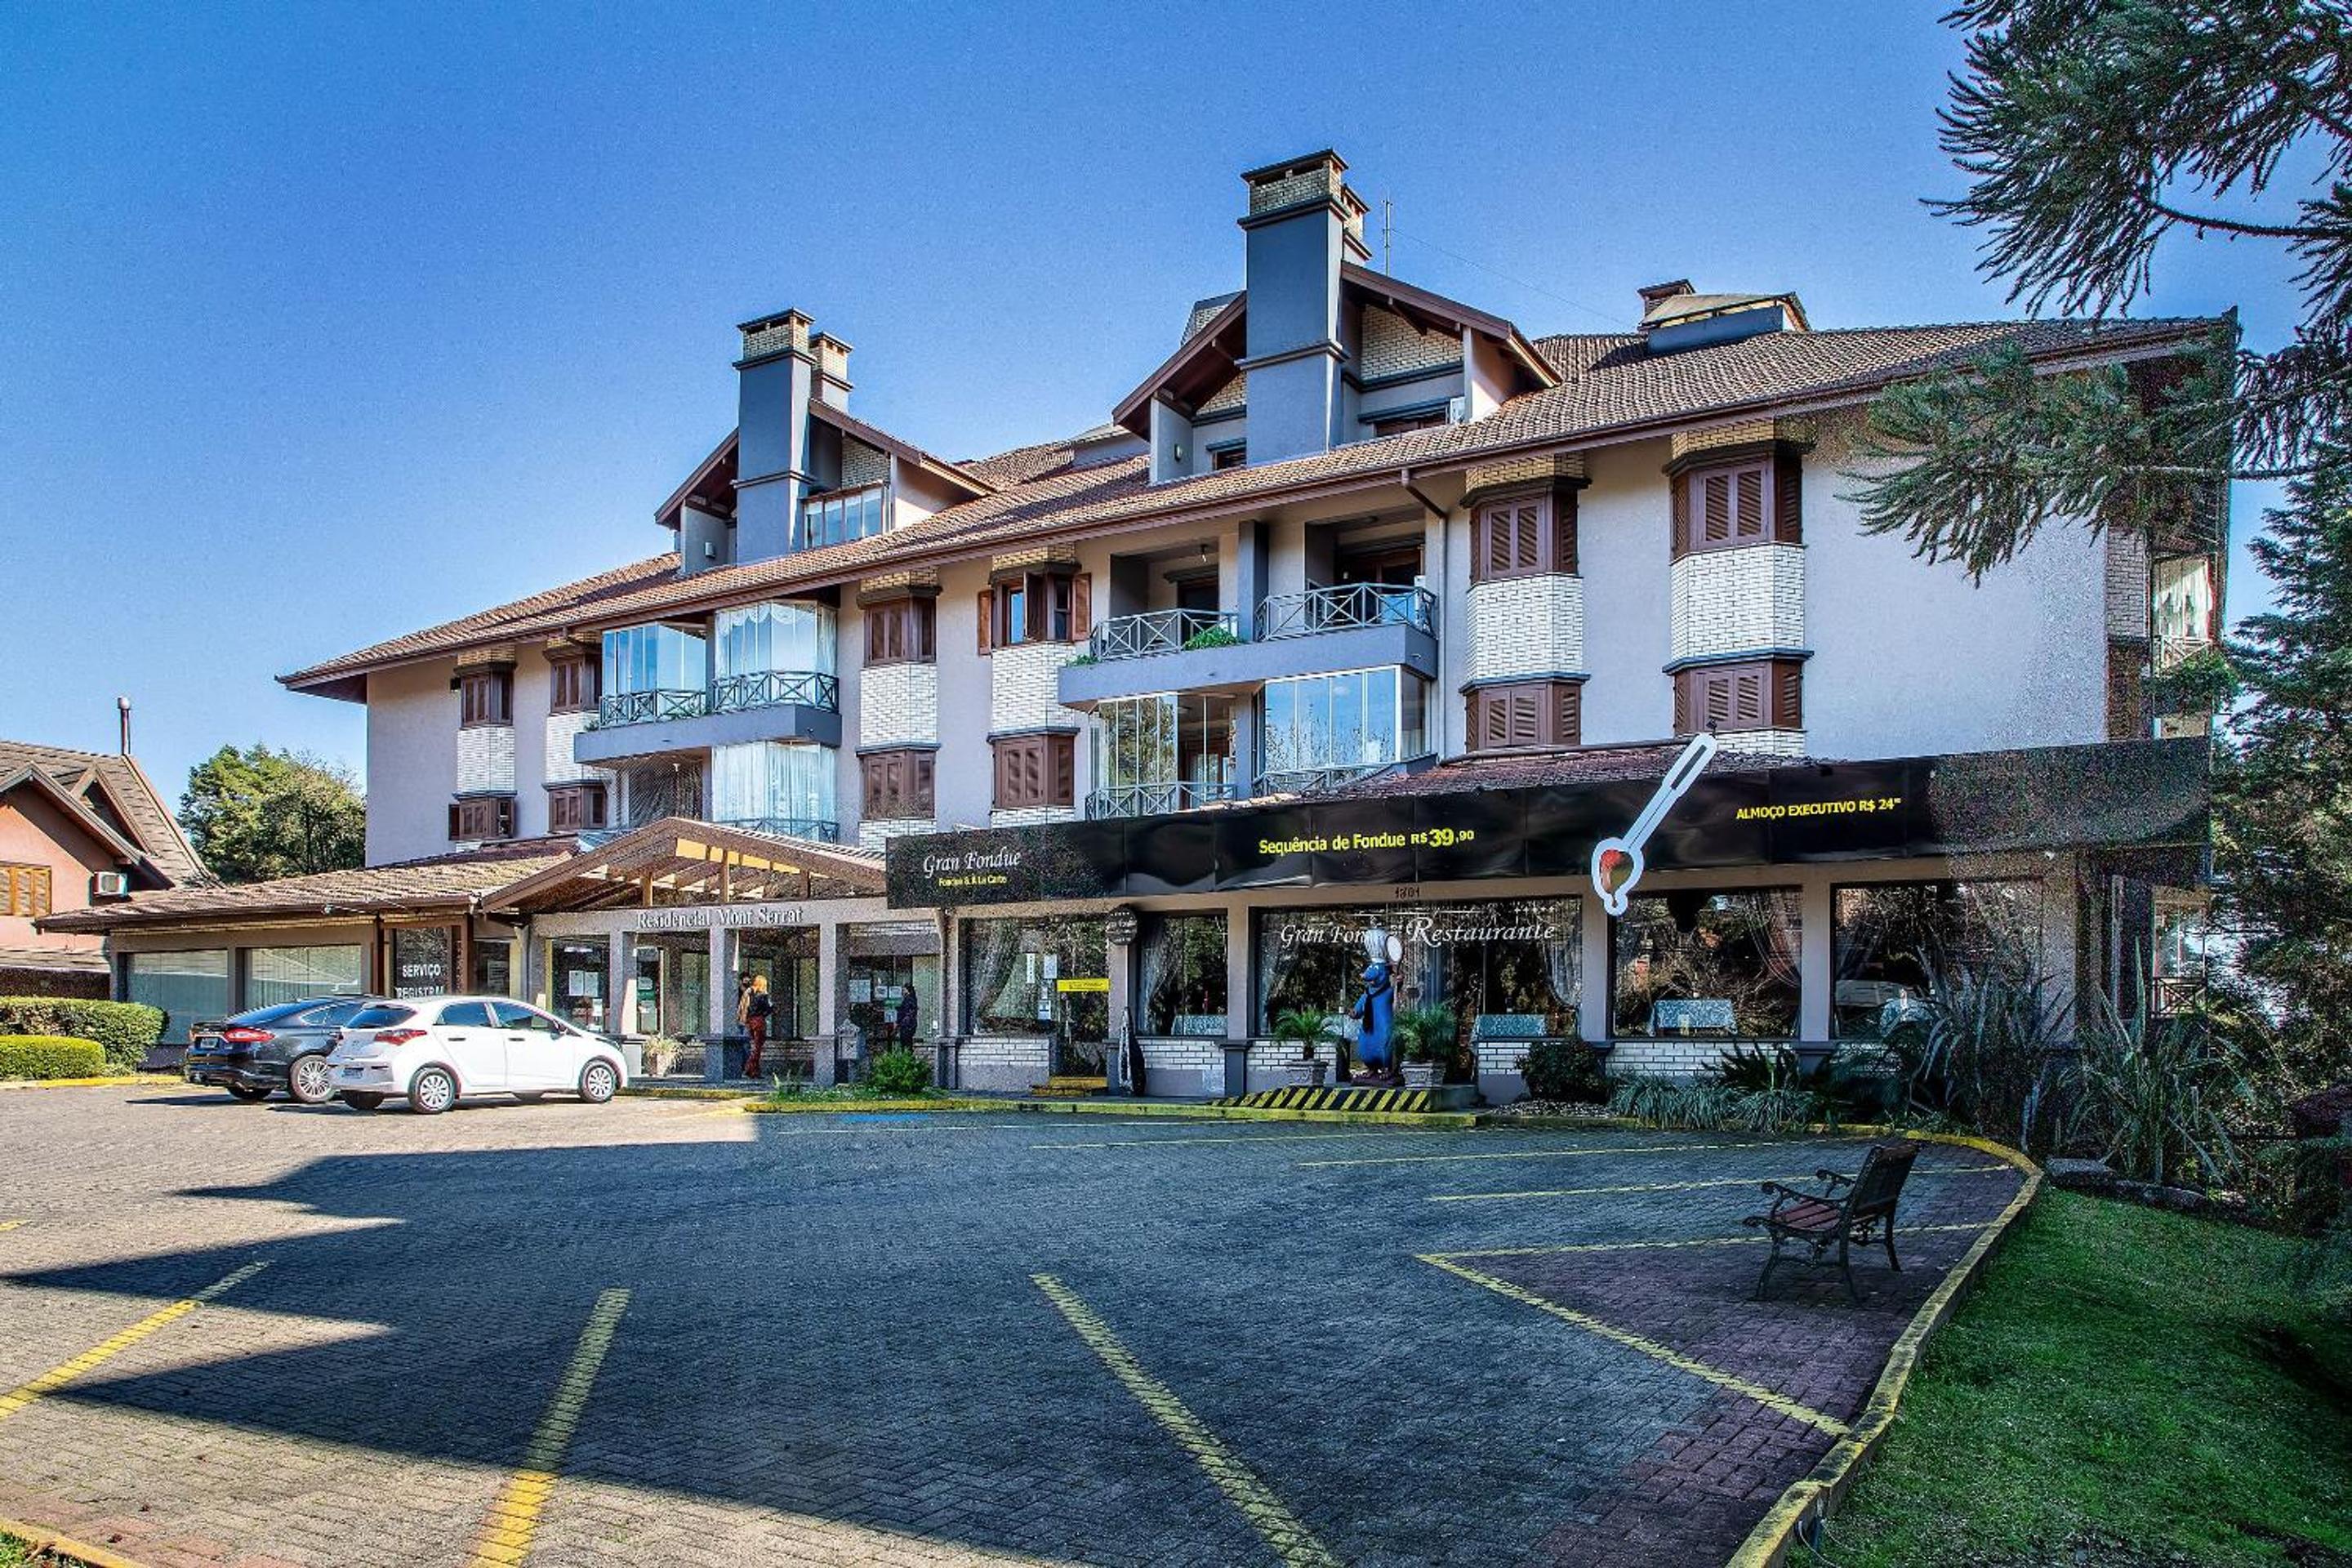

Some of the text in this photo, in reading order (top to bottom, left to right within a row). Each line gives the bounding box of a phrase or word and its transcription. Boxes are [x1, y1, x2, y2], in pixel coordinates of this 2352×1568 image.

[1736, 804, 1785, 819] ALMOÇO
[1788, 800, 1855, 816] EXECUTIVO
[1258, 835, 1327, 856] Sequência
[1332, 835, 1350, 850] de
[1352, 831, 1405, 849] Fondue
[923, 846, 1022, 879] Gran Fondue
[637, 906, 804, 929] Residencial Mont Serrat
[1281, 924, 1324, 949] Gran
[1406, 916, 1556, 947] Restaurante
[402, 964, 441, 978] SERVIÇO
